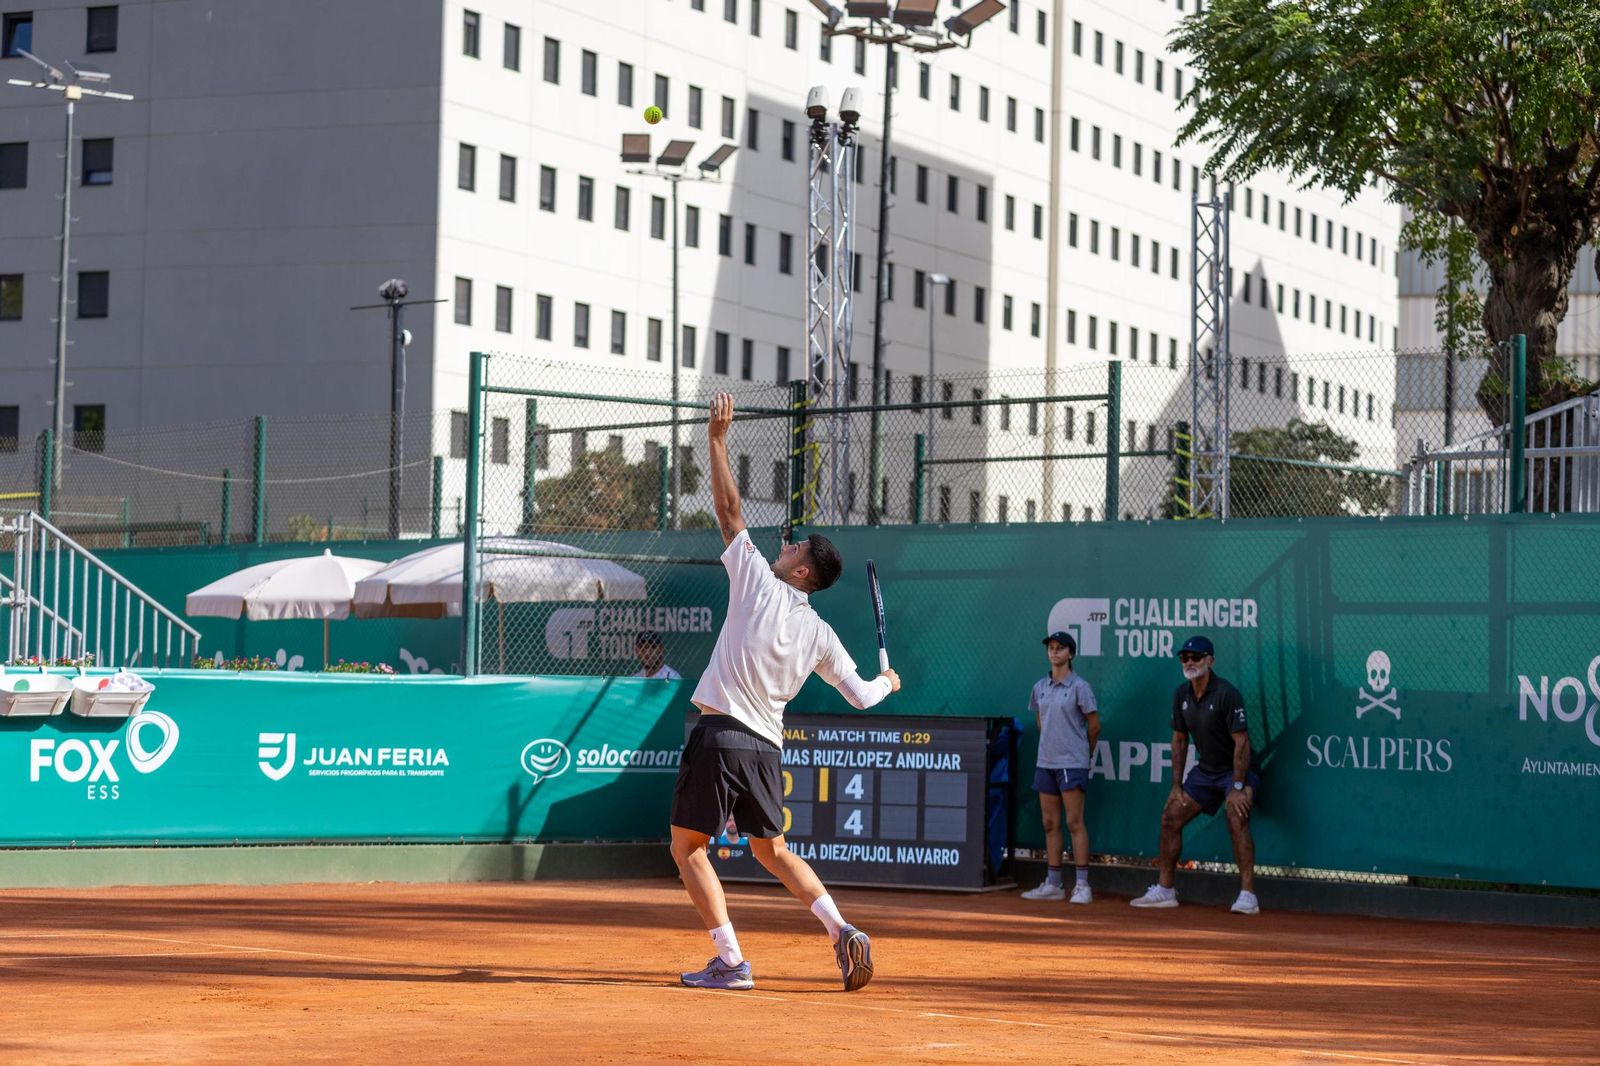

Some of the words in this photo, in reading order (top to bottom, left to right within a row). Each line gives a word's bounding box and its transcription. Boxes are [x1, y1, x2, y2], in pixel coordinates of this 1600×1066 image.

[600, 607, 713, 632] CHALLENGER
[1087, 612, 1107, 622] ATP
[1115, 598, 1258, 628] CHALLENGER
[600, 634, 638, 660] TOU
[1115, 629, 1174, 658] TOUR
[782, 729, 808, 741] NAL
[818, 730, 866, 742] MATCH
[868, 731, 901, 743] TIME
[903, 732, 931, 744] 0:29
[30, 739, 120, 783] FOX
[303, 747, 373, 766] JUAN
[377, 748, 450, 766] FERIA
[576, 744, 685, 766] solocanari
[781, 748, 810, 766] MAS
[813, 749, 892, 768] RUIZ/LOPEZ
[895, 752, 961, 770] ANDUJAR
[1306, 734, 1453, 773] SCALPERS
[308, 769, 340, 777] SERVICIOS
[381, 769, 398, 777] PARA
[398, 769, 406, 777] EL
[406, 769, 445, 777] TRANSPORTE
[87, 785, 120, 800] ESS
[845, 773, 864, 800] 4
[844, 809, 863, 836] 4
[731, 849, 744, 858] ESP
[785, 842, 816, 859] ILLA
[820, 844, 894, 863] DIEZ/PUJOL
[897, 847, 960, 866] NAVARRO
